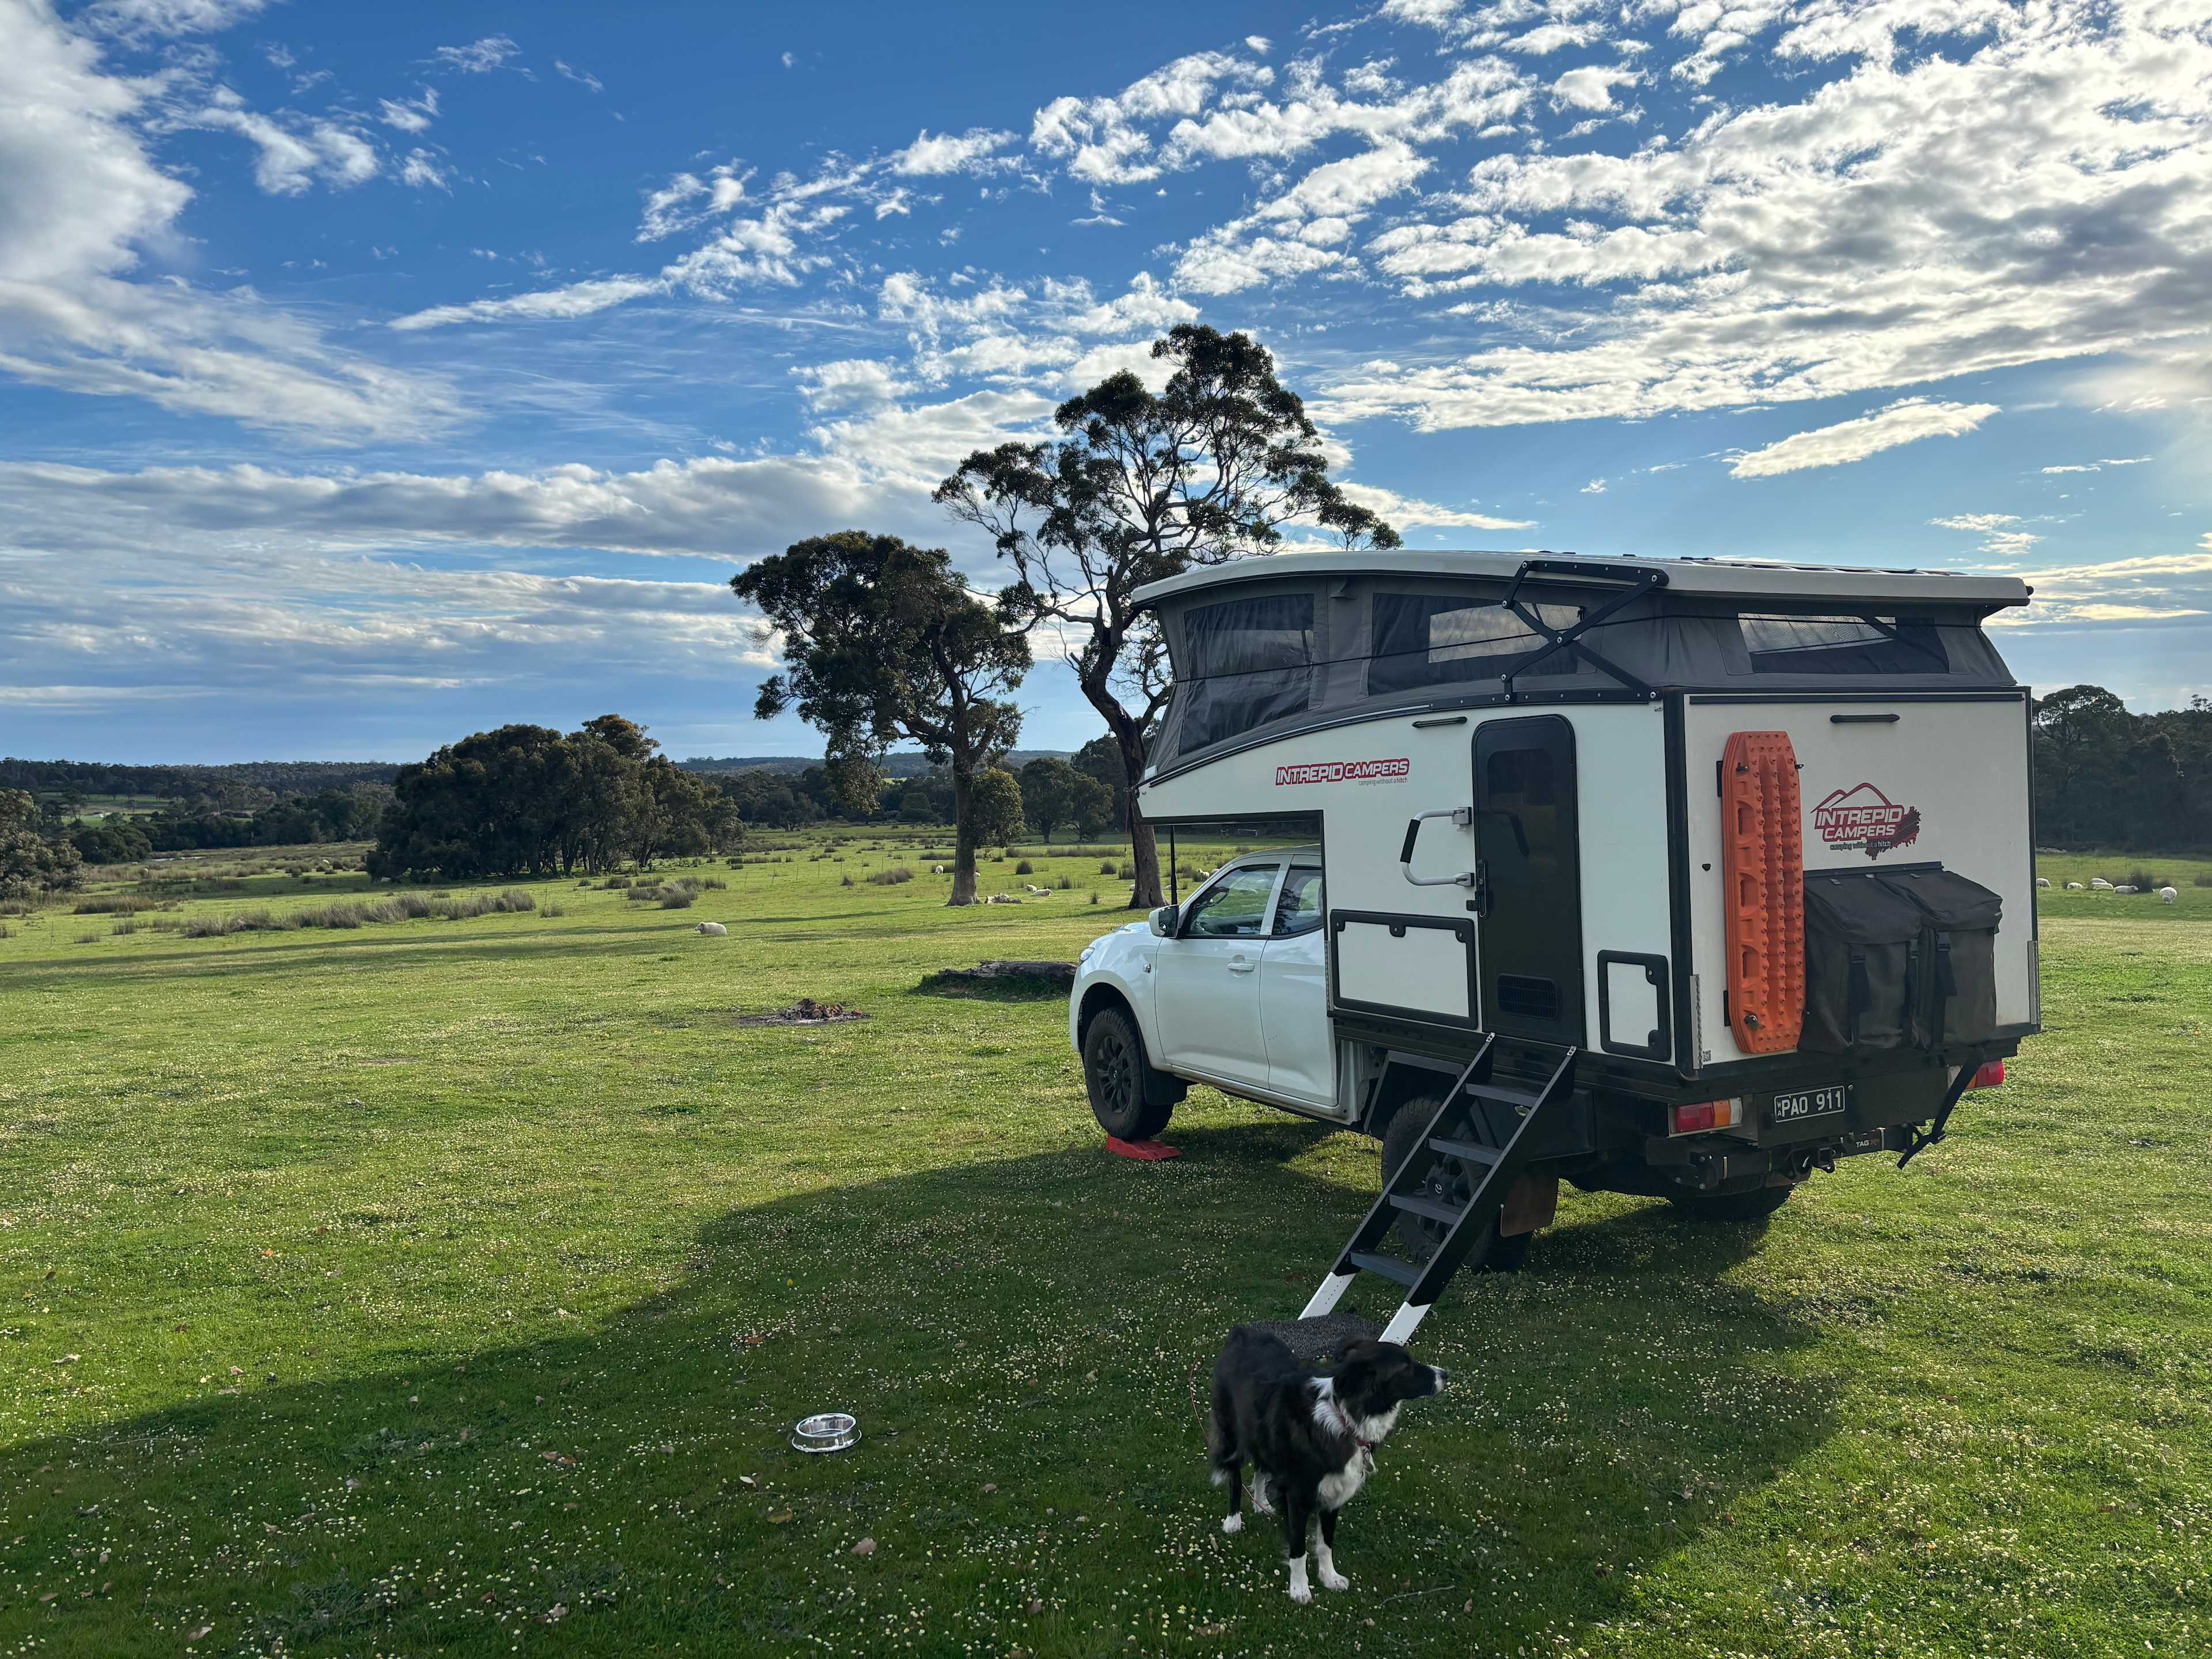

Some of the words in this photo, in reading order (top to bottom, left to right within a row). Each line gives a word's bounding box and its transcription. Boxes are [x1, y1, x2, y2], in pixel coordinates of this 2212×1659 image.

[1276, 763, 1344, 785] INTREPID
[1344, 759, 1410, 778] CAMPERS
[1817, 808, 1903, 827] INTREPID
[1824, 824, 1896, 839] CAMPERS
[1816, 1090, 1841, 1111] 911
